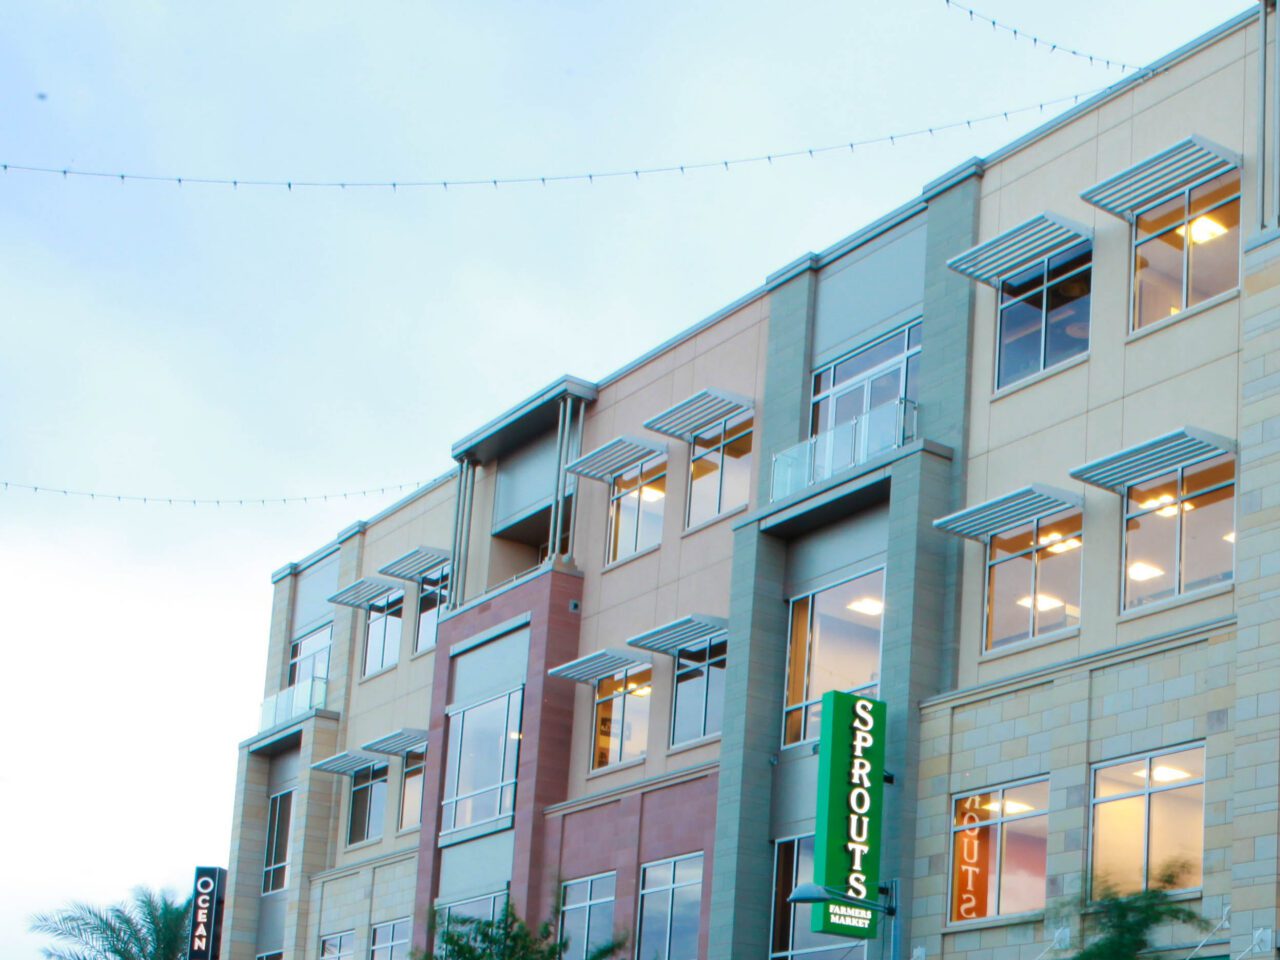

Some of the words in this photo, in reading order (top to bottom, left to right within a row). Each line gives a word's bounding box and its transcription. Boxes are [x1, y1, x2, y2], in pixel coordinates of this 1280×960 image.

[847, 699, 874, 899] SPROUTS
[193, 876, 215, 951] OCEAN
[829, 904, 872, 919] FARMERS
[830, 914, 870, 928] MARKET
